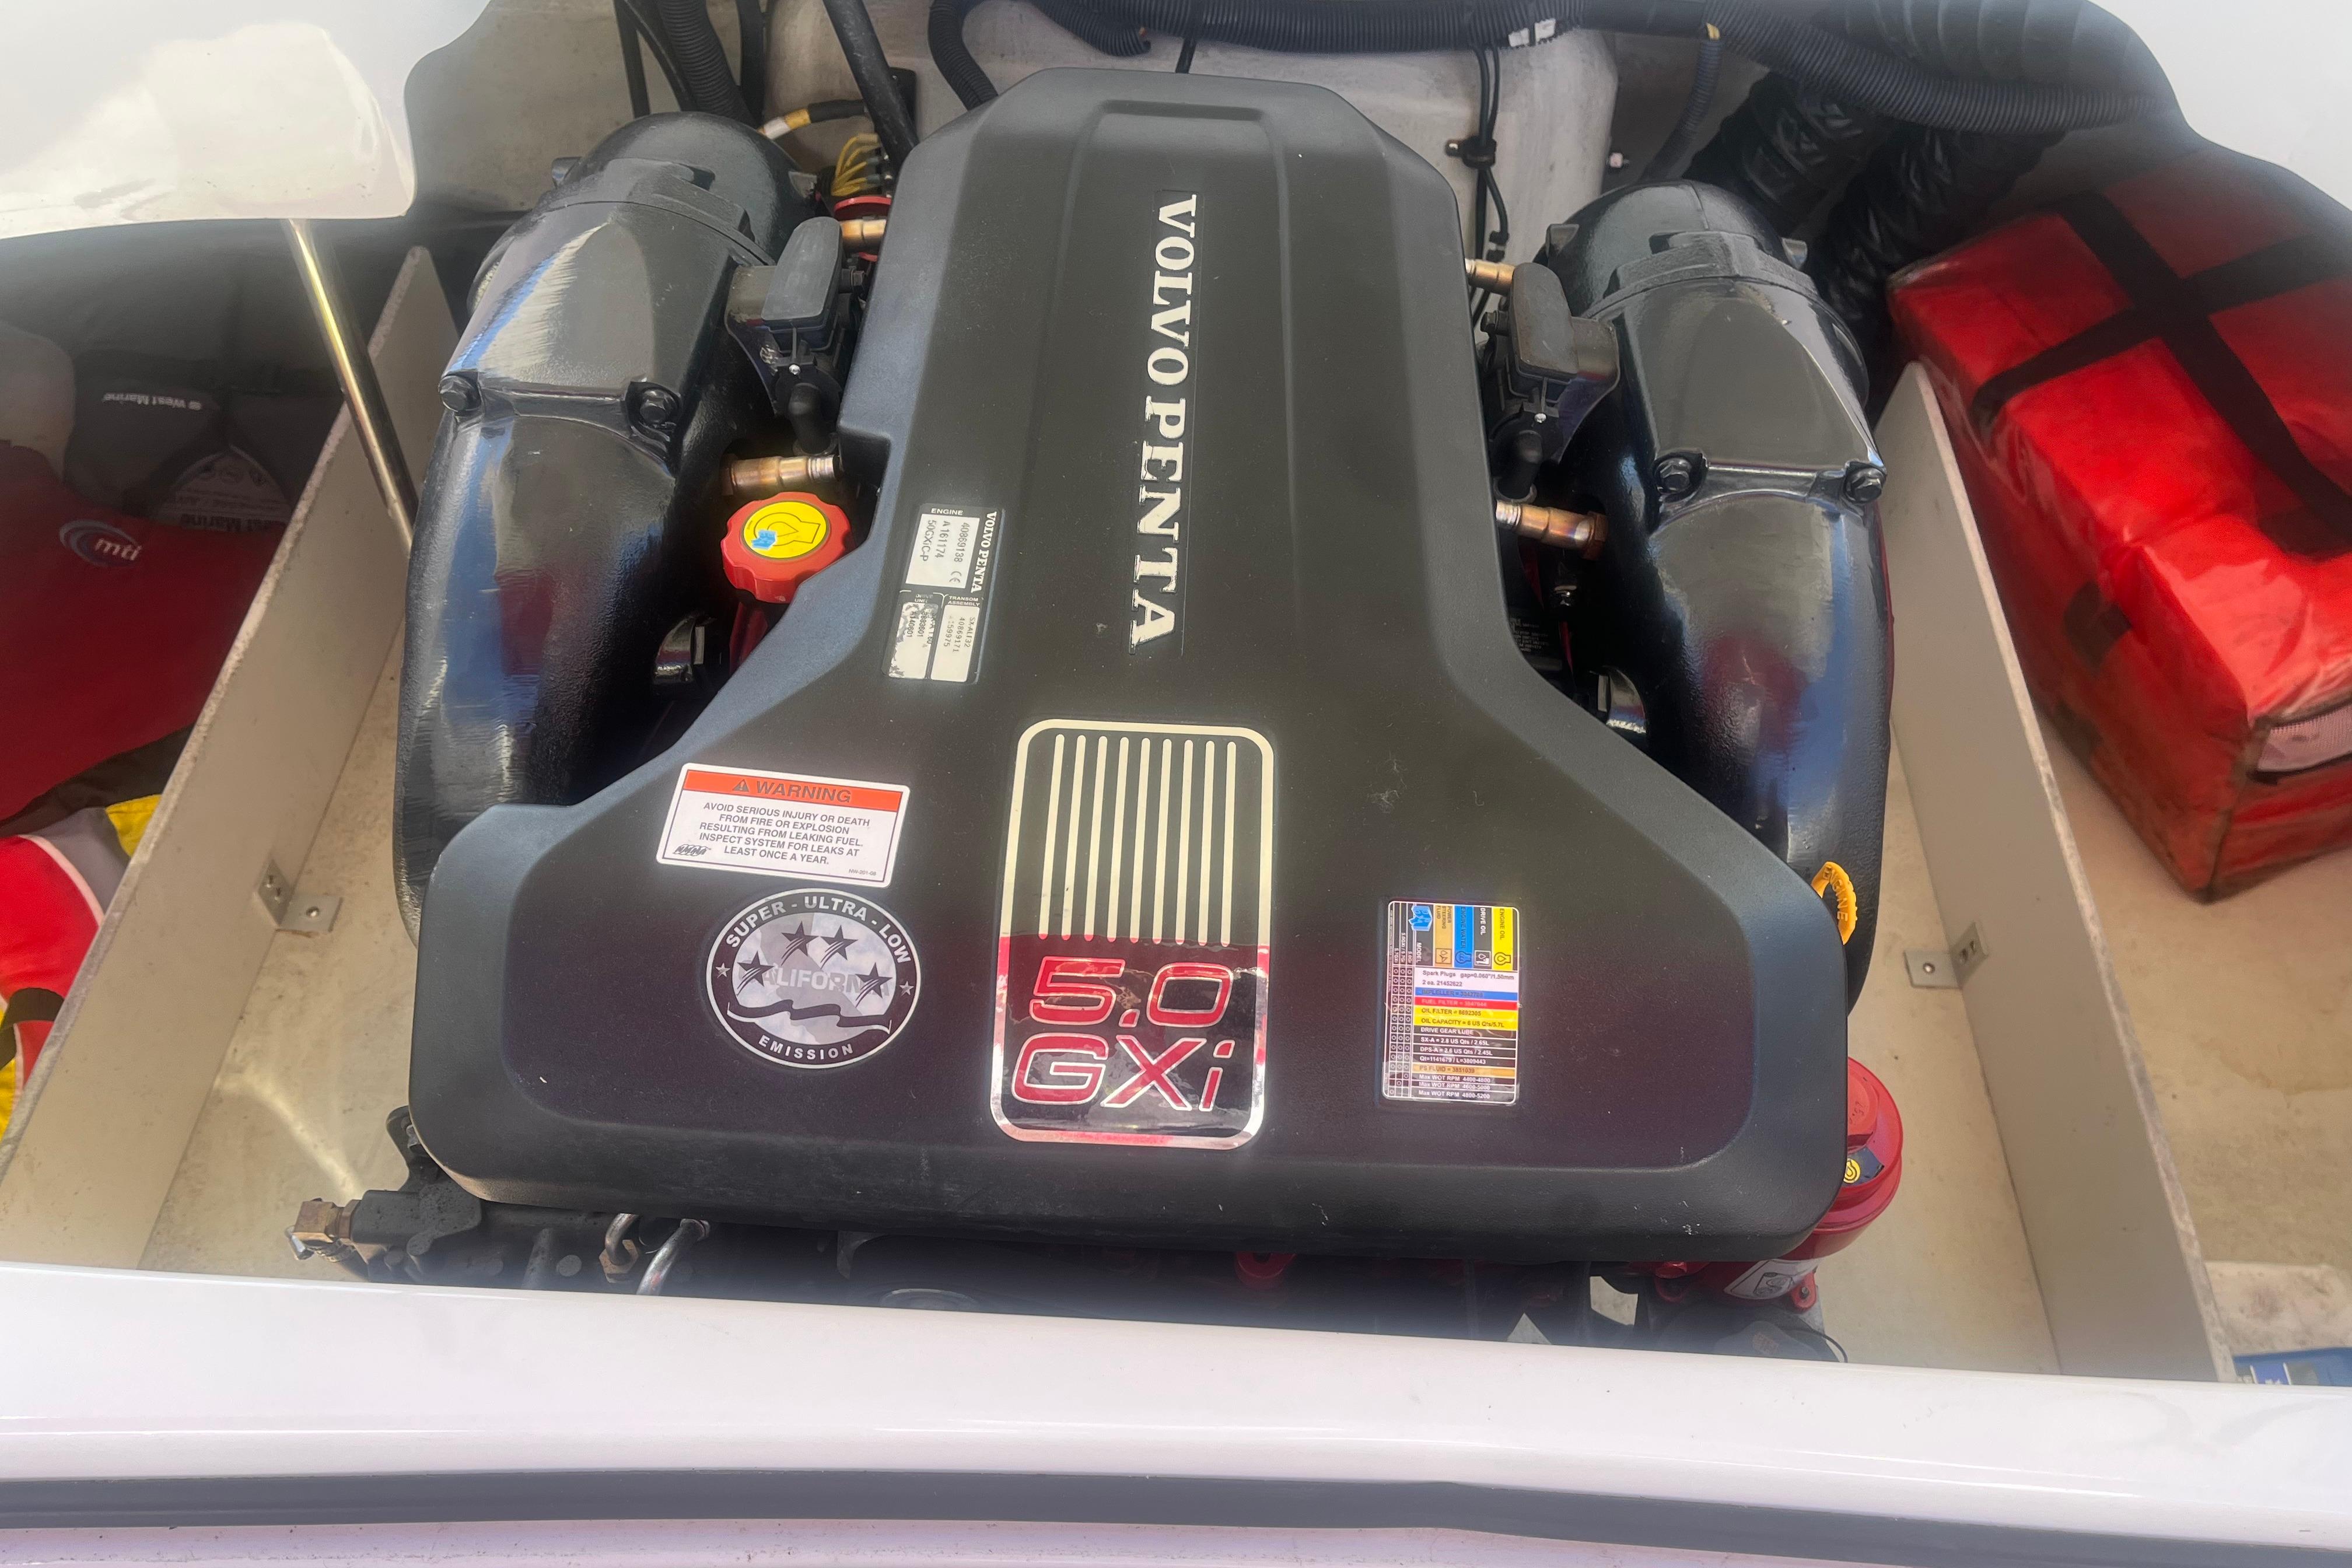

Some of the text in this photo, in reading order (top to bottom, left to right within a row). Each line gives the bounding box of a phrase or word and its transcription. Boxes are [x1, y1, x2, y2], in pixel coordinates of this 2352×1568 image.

[102, 393, 187, 408] West Marine
[1128, 193, 1197, 655] VOLVO PENTA
[931, 508, 964, 516] ENGINE
[971, 511, 998, 593] VOLVO PENTA
[757, 780, 852, 803] WARNING
[703, 802, 870, 827] AVOID SERIOUS INJURY OR DEATH
[719, 814, 850, 835] FROM FIRE OR EXPLOSION
[699, 822, 863, 847] RESULTING FROM LEAKING FUEL.
[699, 832, 860, 857] INSPECT SYSTEM FOR LEAKS AT
[724, 845, 829, 864] LEAST ONCE A YEAR.
[1823, 866, 1848, 921] ENGINE
[726, 900, 787, 948] SUPER
[804, 895, 868, 922] ULTRA
[878, 923, 912, 964] LOW
[1029, 956, 1235, 1028] 5.0
[758, 1034, 854, 1061] EMISSION
[1010, 1032, 1236, 1112] GXi
